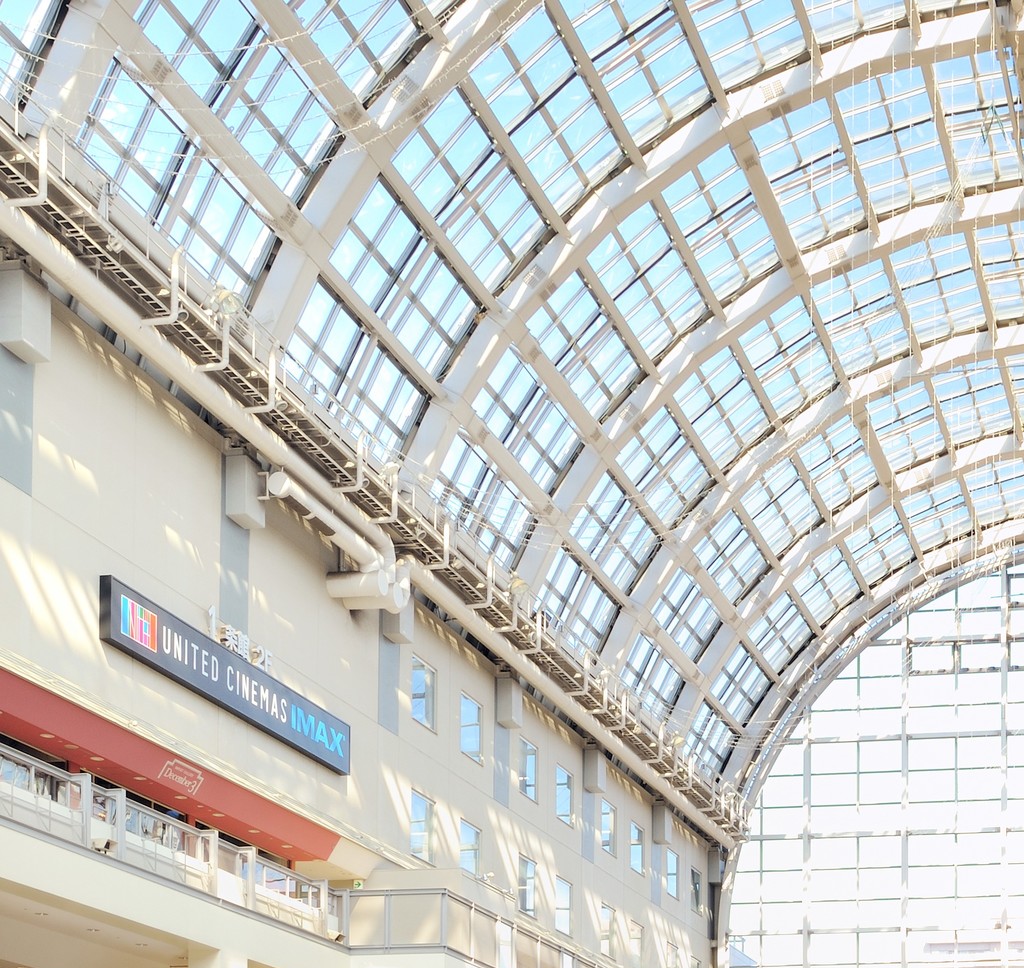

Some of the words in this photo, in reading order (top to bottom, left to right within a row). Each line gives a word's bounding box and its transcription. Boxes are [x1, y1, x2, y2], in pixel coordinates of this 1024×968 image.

[162, 625, 219, 682] UNITED
[227, 666, 287, 724] CINEMAS
[291, 703, 344, 758] IMAX
